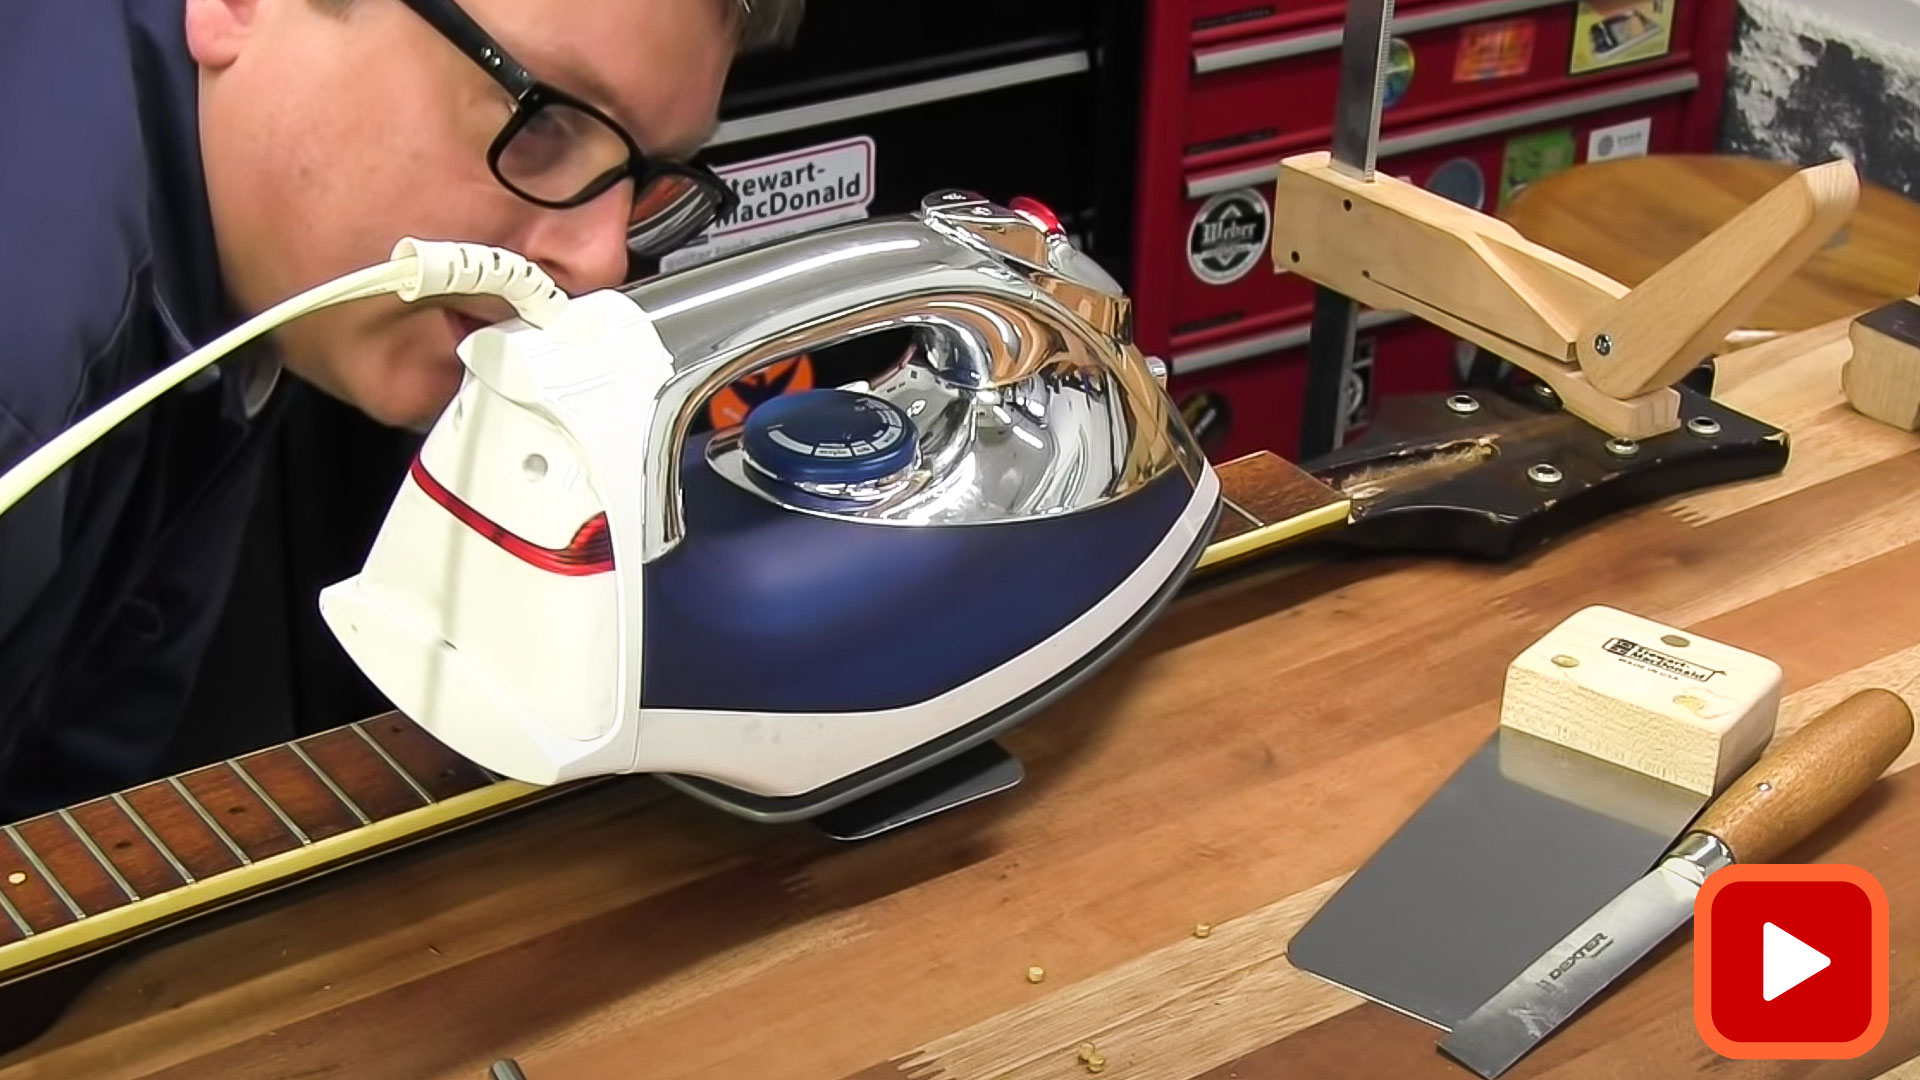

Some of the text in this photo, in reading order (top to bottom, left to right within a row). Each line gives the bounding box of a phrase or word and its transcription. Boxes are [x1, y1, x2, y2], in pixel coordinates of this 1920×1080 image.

[730, 161, 826, 197] tewart-
[1202, 220, 1257, 244] Weber
[1630, 651, 1707, 679] MacDonald
[1549, 931, 1609, 980] DEXTER
